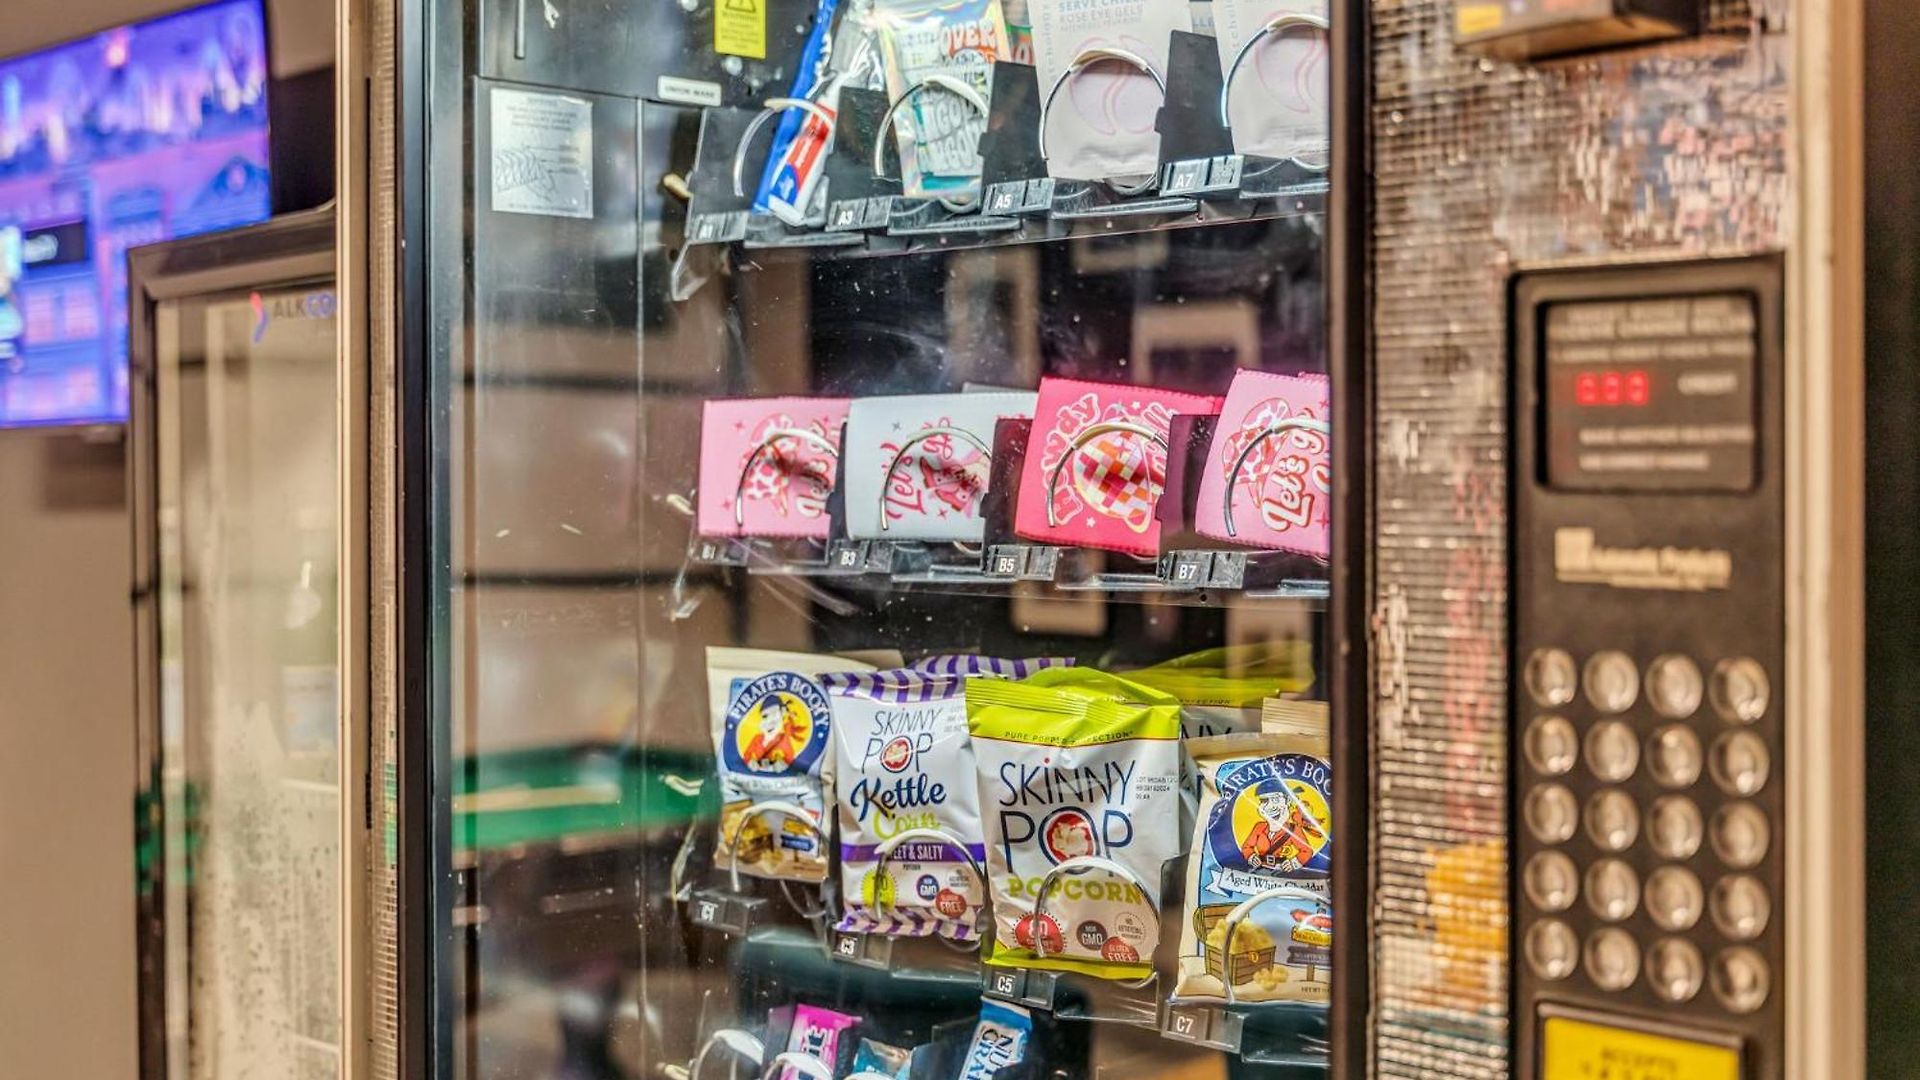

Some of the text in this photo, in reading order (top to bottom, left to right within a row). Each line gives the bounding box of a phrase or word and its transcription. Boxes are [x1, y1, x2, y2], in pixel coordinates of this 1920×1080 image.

[1176, 173, 1194, 188] A7
[995, 194, 1012, 209] A5
[838, 211, 854, 226] A3
[1261, 454, 1315, 533] Let's
[841, 550, 856, 567] B3
[998, 557, 1014, 574] B5
[1178, 562, 1197, 580] B7
[729, 673, 830, 727] PIRATE'S BOOTY
[861, 732, 934, 774] POP
[1222, 756, 1296, 801] PIRATE'S
[850, 773, 948, 823] Kettle
[1000, 805, 1135, 877] POP
[909, 844, 916, 860] &
[917, 845, 944, 861] SALTY
[1225, 871, 1251, 888] Aged
[919, 884, 938, 897] GMO
[1007, 876, 1143, 906] POPCORN
[940, 901, 962, 914] FREE
[1081, 932, 1103, 945] GMO
[840, 940, 856, 955] C3
[1107, 951, 1133, 962] FREE
[996, 976, 1013, 993] C5
[1176, 1016, 1194, 1034] C7
